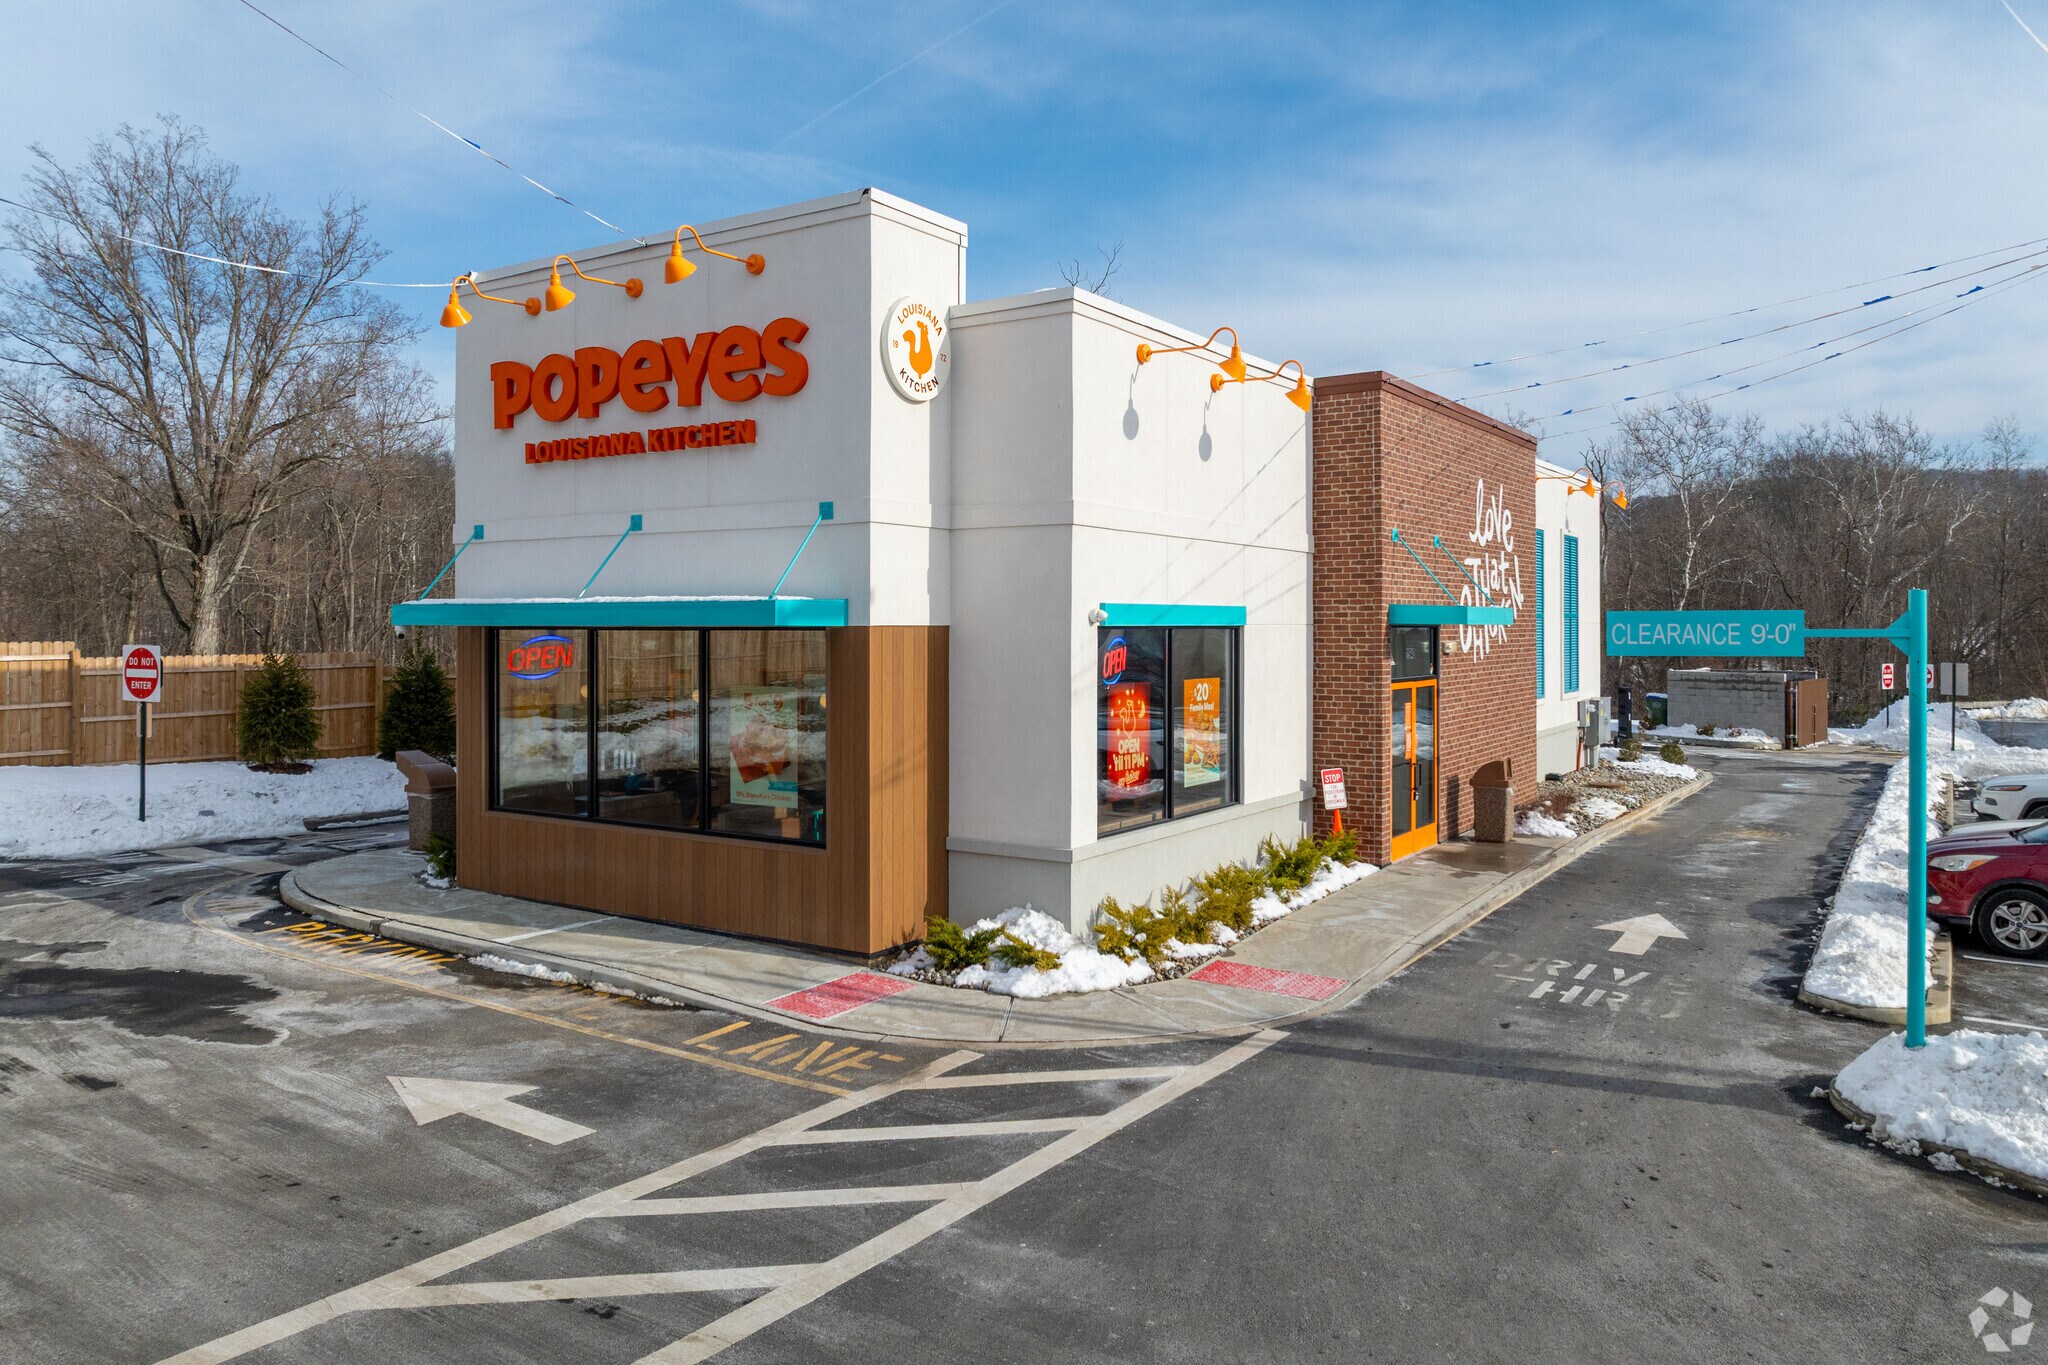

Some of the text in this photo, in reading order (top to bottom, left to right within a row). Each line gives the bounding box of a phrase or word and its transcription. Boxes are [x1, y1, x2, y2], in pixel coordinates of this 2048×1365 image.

[898, 303, 943, 336] LOUISIANA
[940, 353, 947, 362] 72
[900, 368, 939, 393] KITCHEN
[525, 419, 757, 464] LOUISIANA KITCHEN
[1611, 623, 1796, 645] CLEARANCE 9'-0"
[128, 657, 154, 666] DO NOT
[507, 644, 574, 672] OPEN
[1102, 646, 1127, 679] OPEN
[131, 681, 152, 690] ENTER
[1118, 737, 1140, 755] OPEN
[1132, 752, 1145, 769] PM
[1324, 773, 1341, 783] STOP
[682, 1020, 906, 1082] LANE
